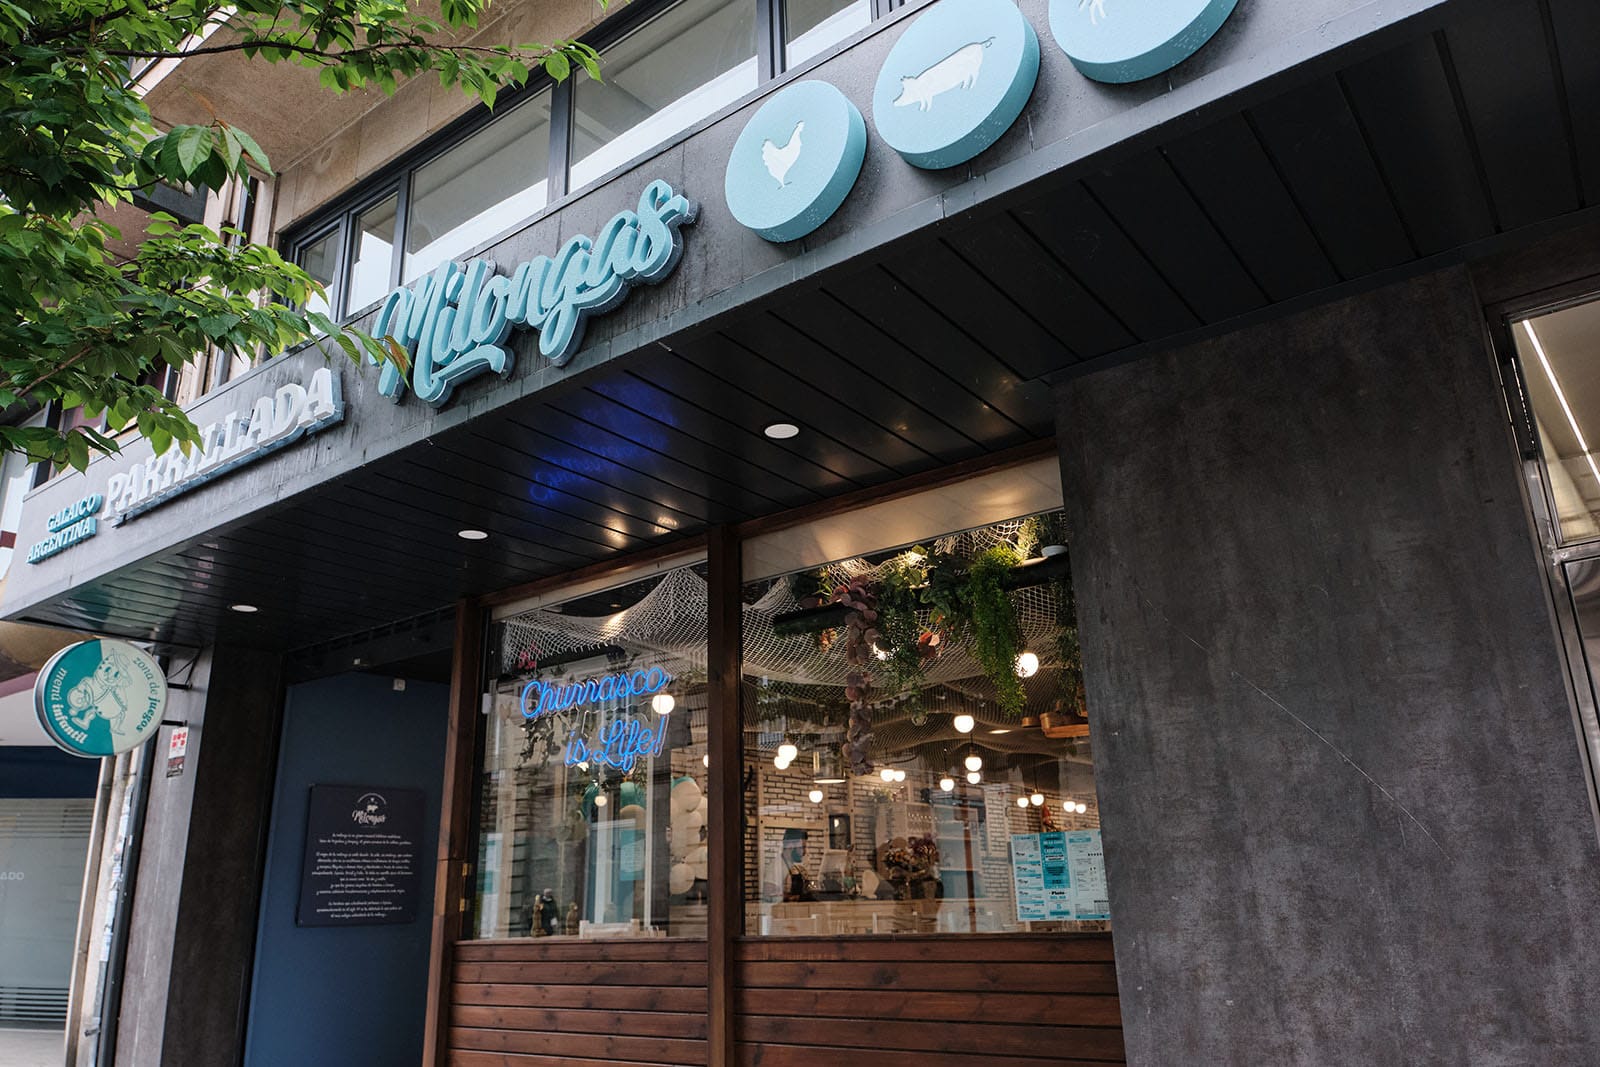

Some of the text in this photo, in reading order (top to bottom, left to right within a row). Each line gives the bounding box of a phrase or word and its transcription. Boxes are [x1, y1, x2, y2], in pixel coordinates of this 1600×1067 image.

[368, 179, 692, 402] Milongas
[47, 494, 102, 532] GALAICO
[25, 517, 97, 563] ARGENTINA
[133, 657, 154, 680] zona
[149, 682, 160, 695] de
[520, 666, 671, 718] Churrasco
[51, 667, 88, 744] menú infantil
[564, 714, 667, 772] is Life!
